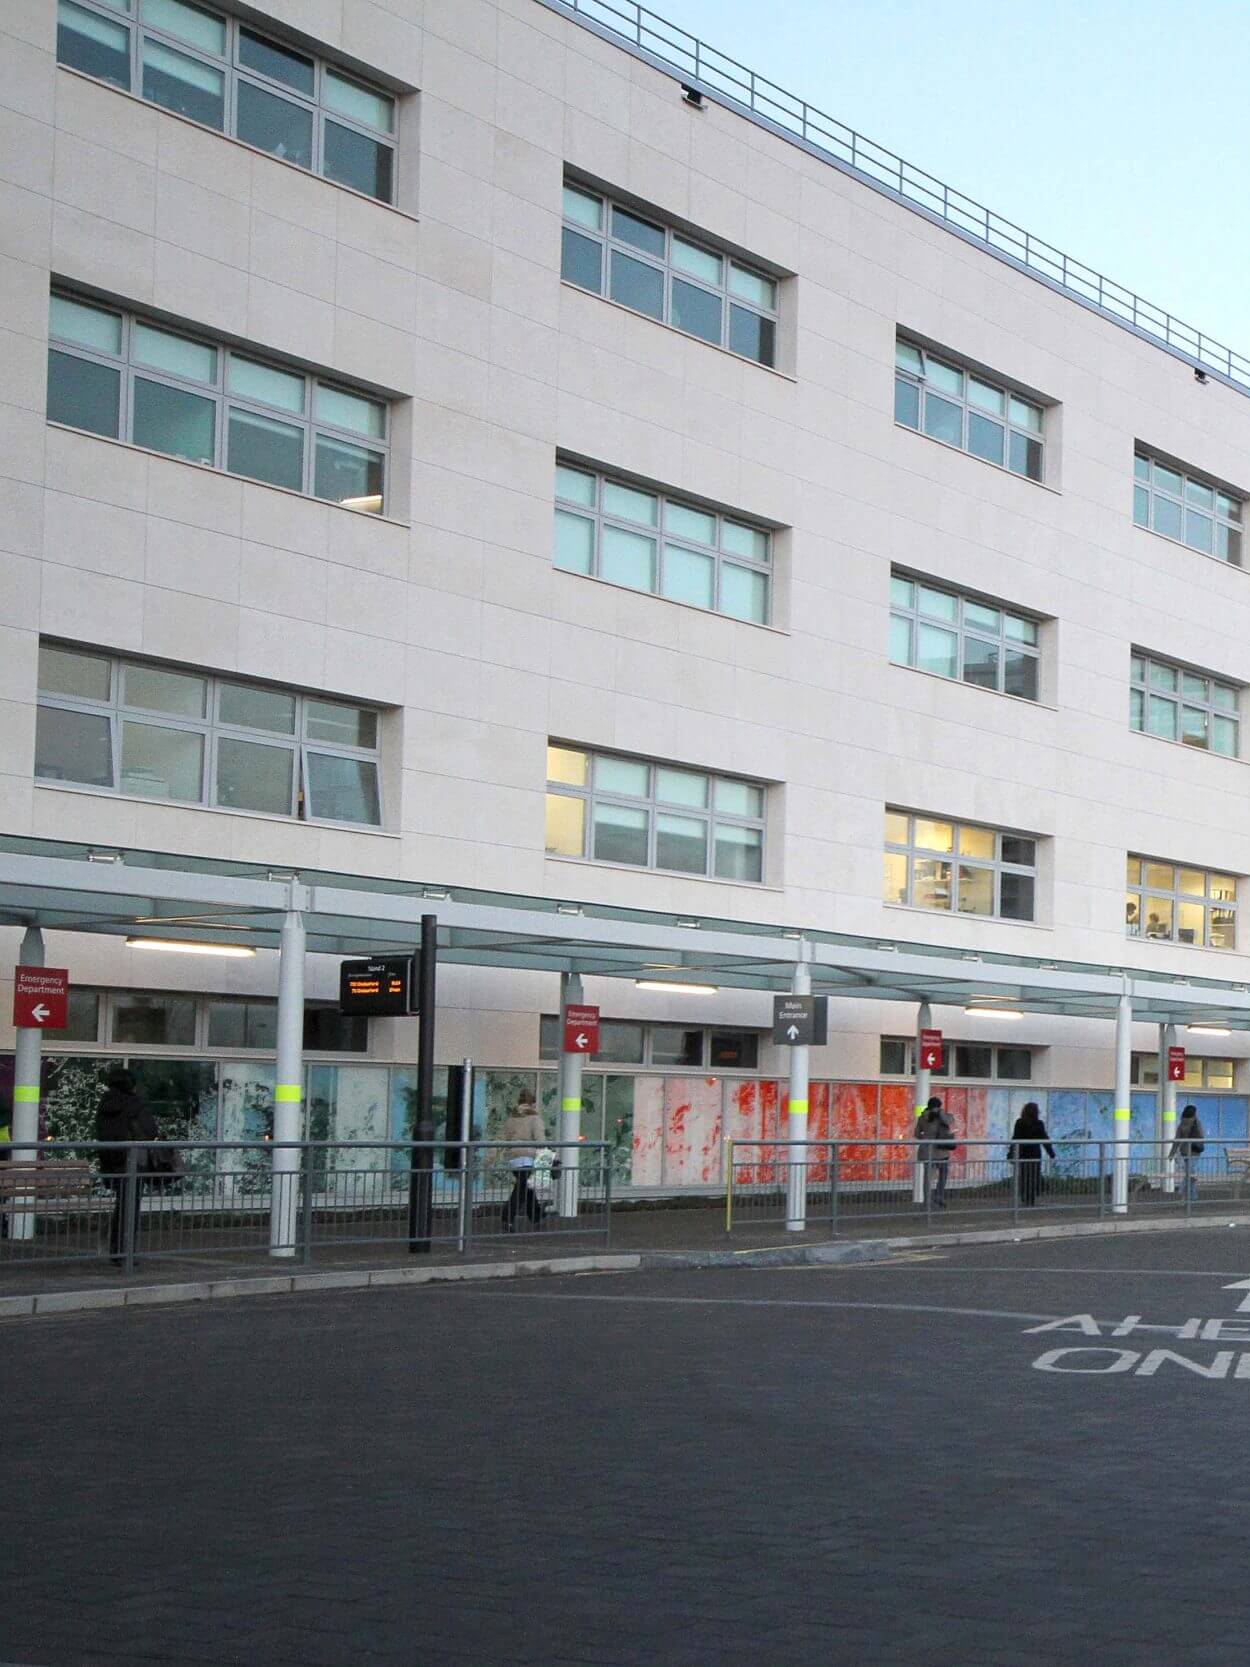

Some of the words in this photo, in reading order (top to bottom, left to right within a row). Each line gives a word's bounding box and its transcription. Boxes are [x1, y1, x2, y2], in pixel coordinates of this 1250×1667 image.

[20, 974, 62, 986] Emergency
[17, 984, 65, 995] Department
[568, 1010, 597, 1020] Emergency
[778, 1011, 808, 1019] Entrance
[567, 1018, 598, 1026] Department
